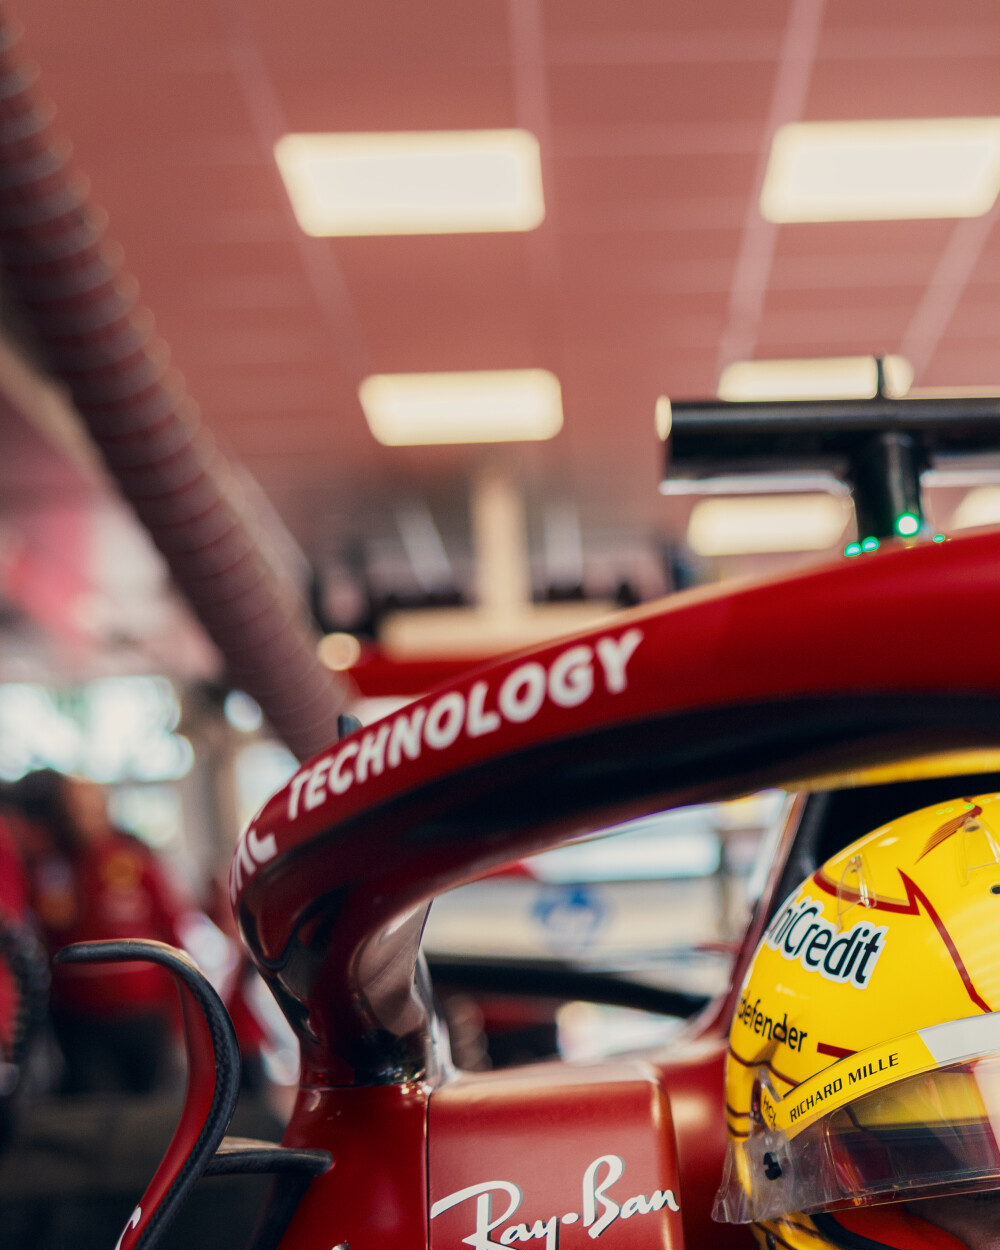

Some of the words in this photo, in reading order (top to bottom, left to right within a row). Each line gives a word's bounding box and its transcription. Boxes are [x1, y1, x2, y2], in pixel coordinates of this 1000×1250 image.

[287, 628, 644, 822] TECHNOLOGY
[770, 896, 882, 984] niCredit
[789, 1077, 843, 1123] RICHARD
[848, 1052, 900, 1086] MILLE
